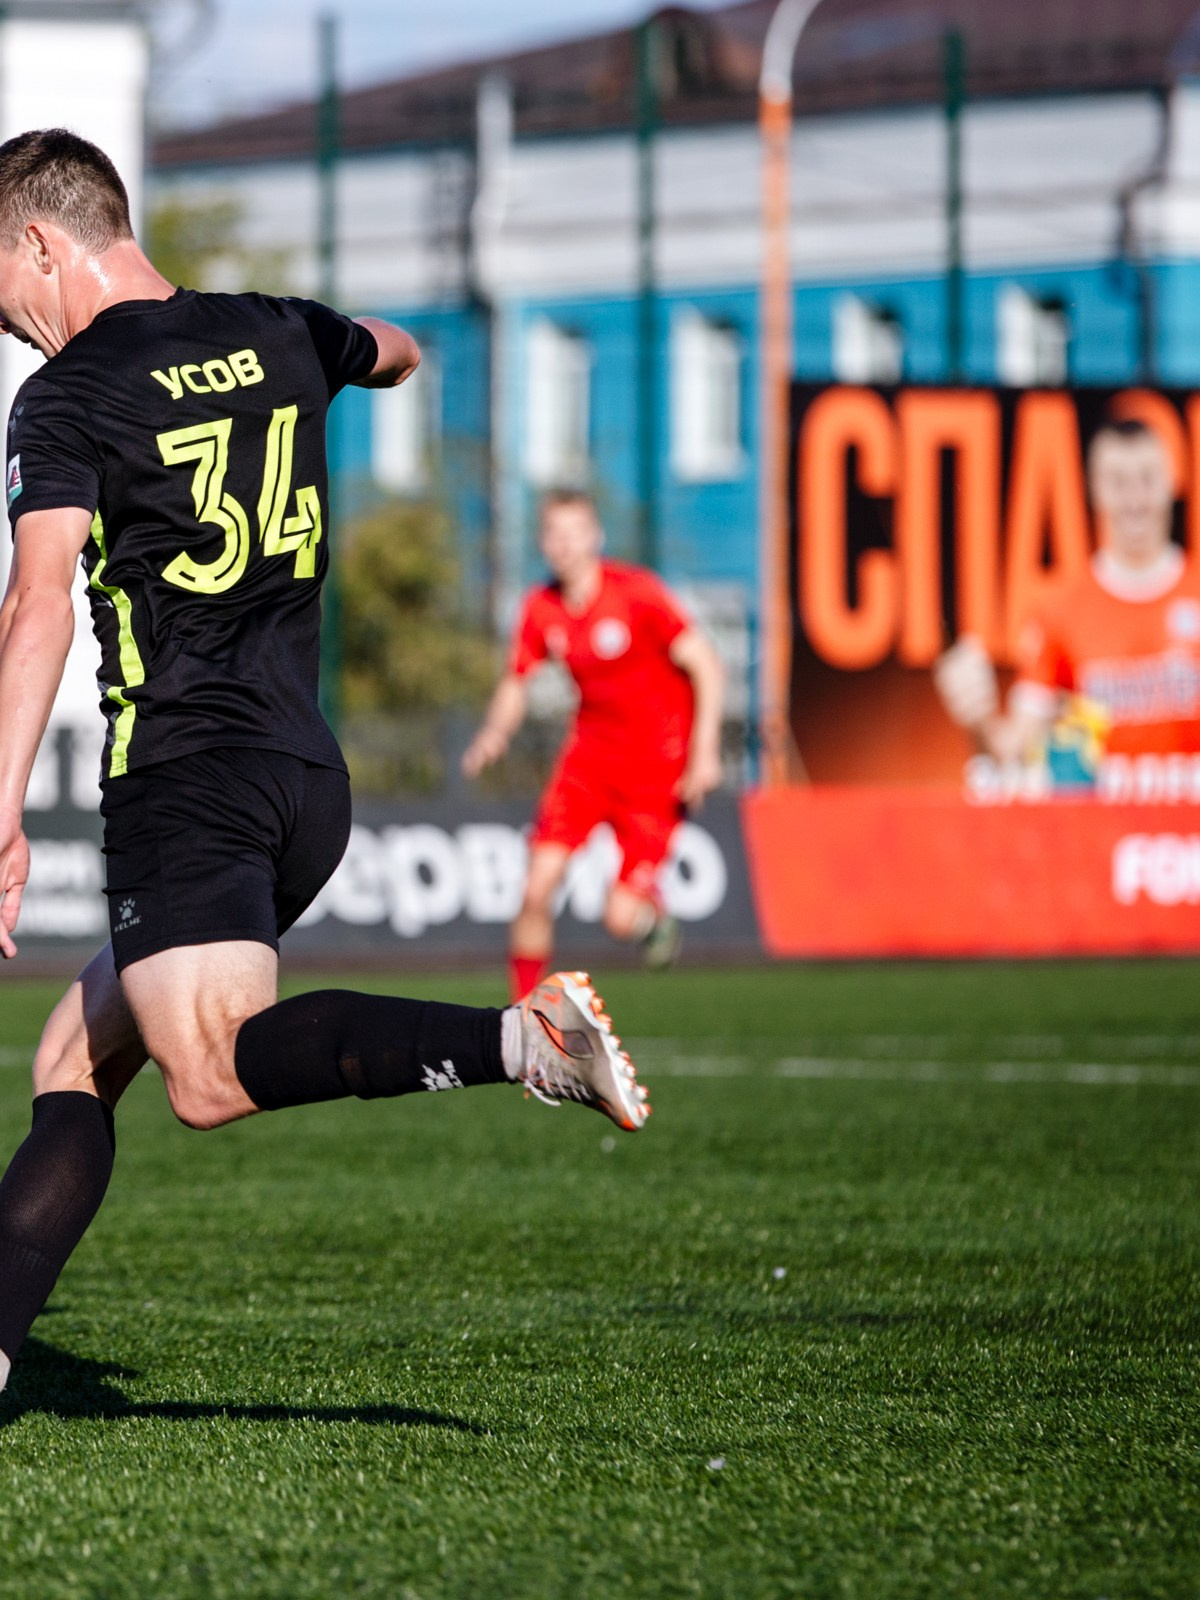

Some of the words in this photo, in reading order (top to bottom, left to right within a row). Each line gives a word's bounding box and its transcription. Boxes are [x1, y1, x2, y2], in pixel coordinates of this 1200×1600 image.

[150, 349, 264, 400] УСОВ
[156, 404, 322, 594] 34
[800, 386, 1200, 667] СПА
[114, 915, 142, 934] KELME
